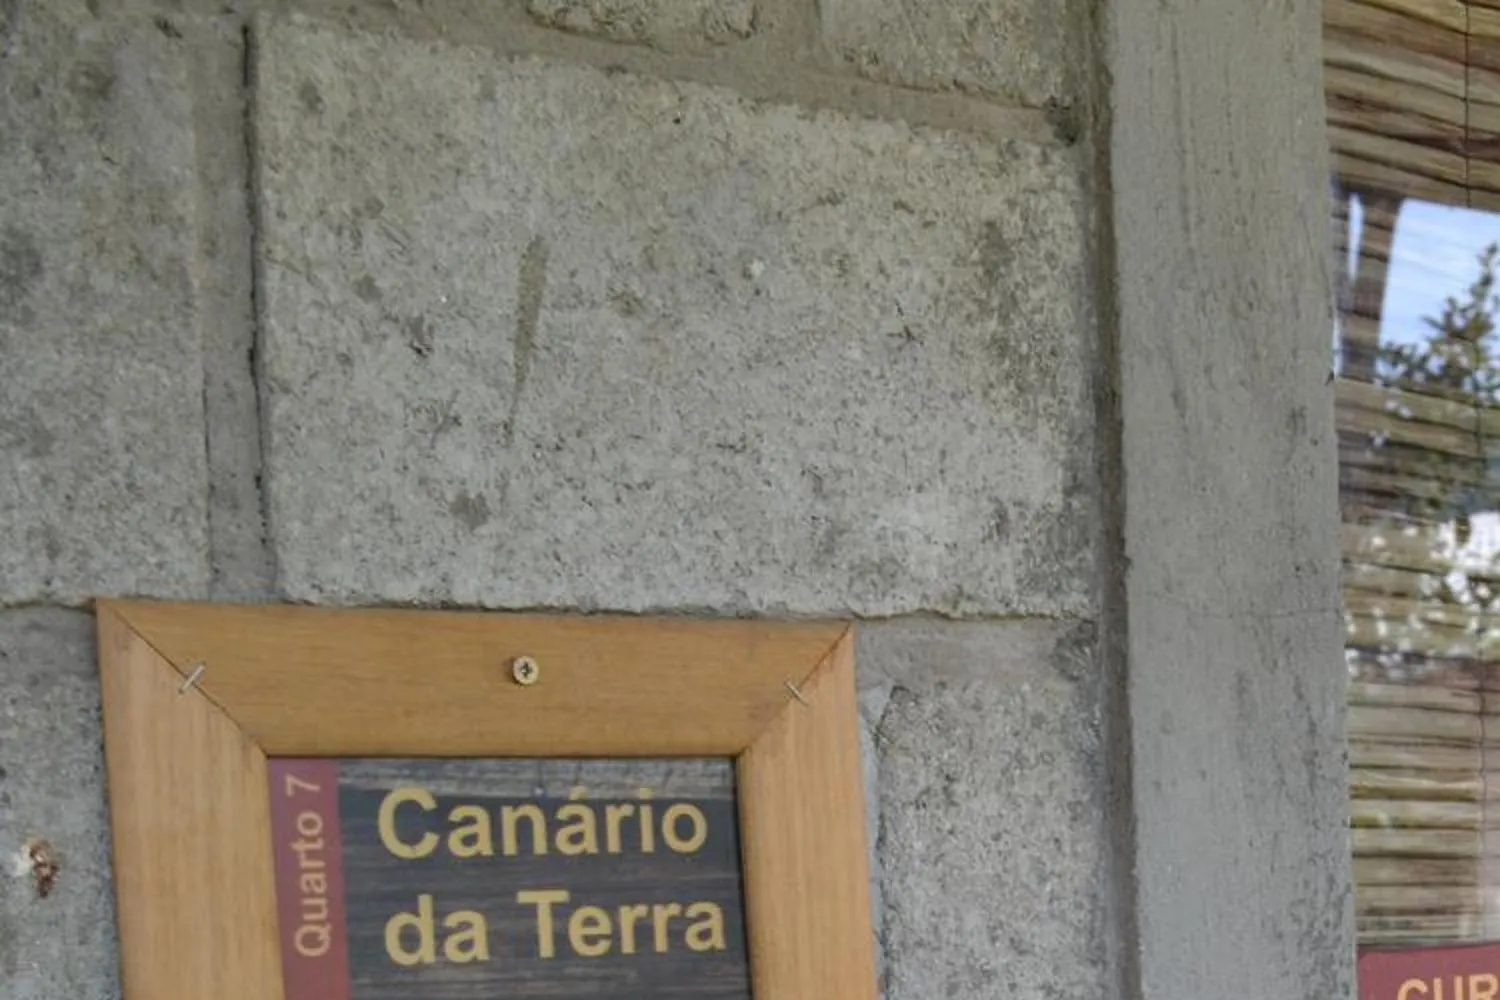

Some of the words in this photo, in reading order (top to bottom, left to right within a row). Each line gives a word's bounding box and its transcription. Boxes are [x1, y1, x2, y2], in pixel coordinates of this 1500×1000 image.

[285, 773, 320, 797] 7
[378, 786, 708, 859] Canário
[289, 810, 332, 956] Quarto
[384, 894, 489, 966] da
[517, 889, 726, 959] Terra
